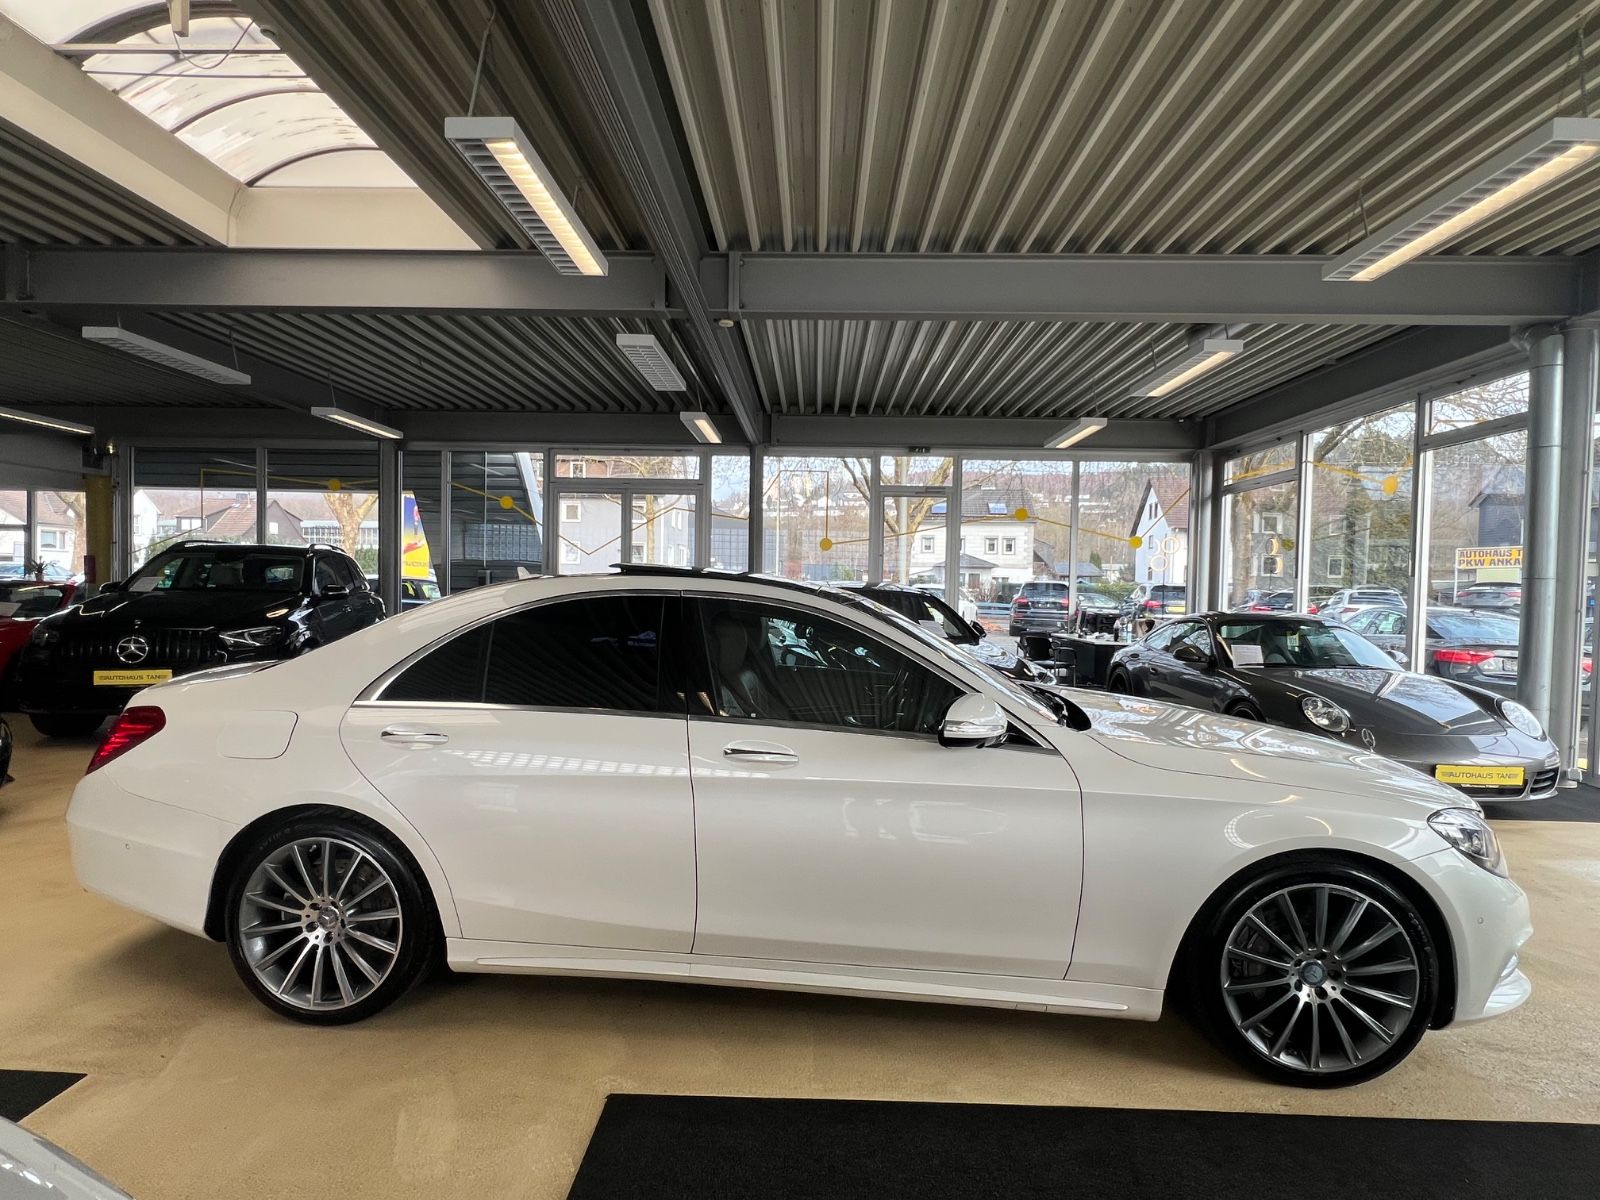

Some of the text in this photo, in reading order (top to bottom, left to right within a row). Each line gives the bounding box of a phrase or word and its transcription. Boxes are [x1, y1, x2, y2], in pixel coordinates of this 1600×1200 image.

[1460, 550, 1512, 558] AUTOHAUS
[1459, 558, 1485, 566] PKW
[1448, 771, 1494, 779] AUTOHAUS
